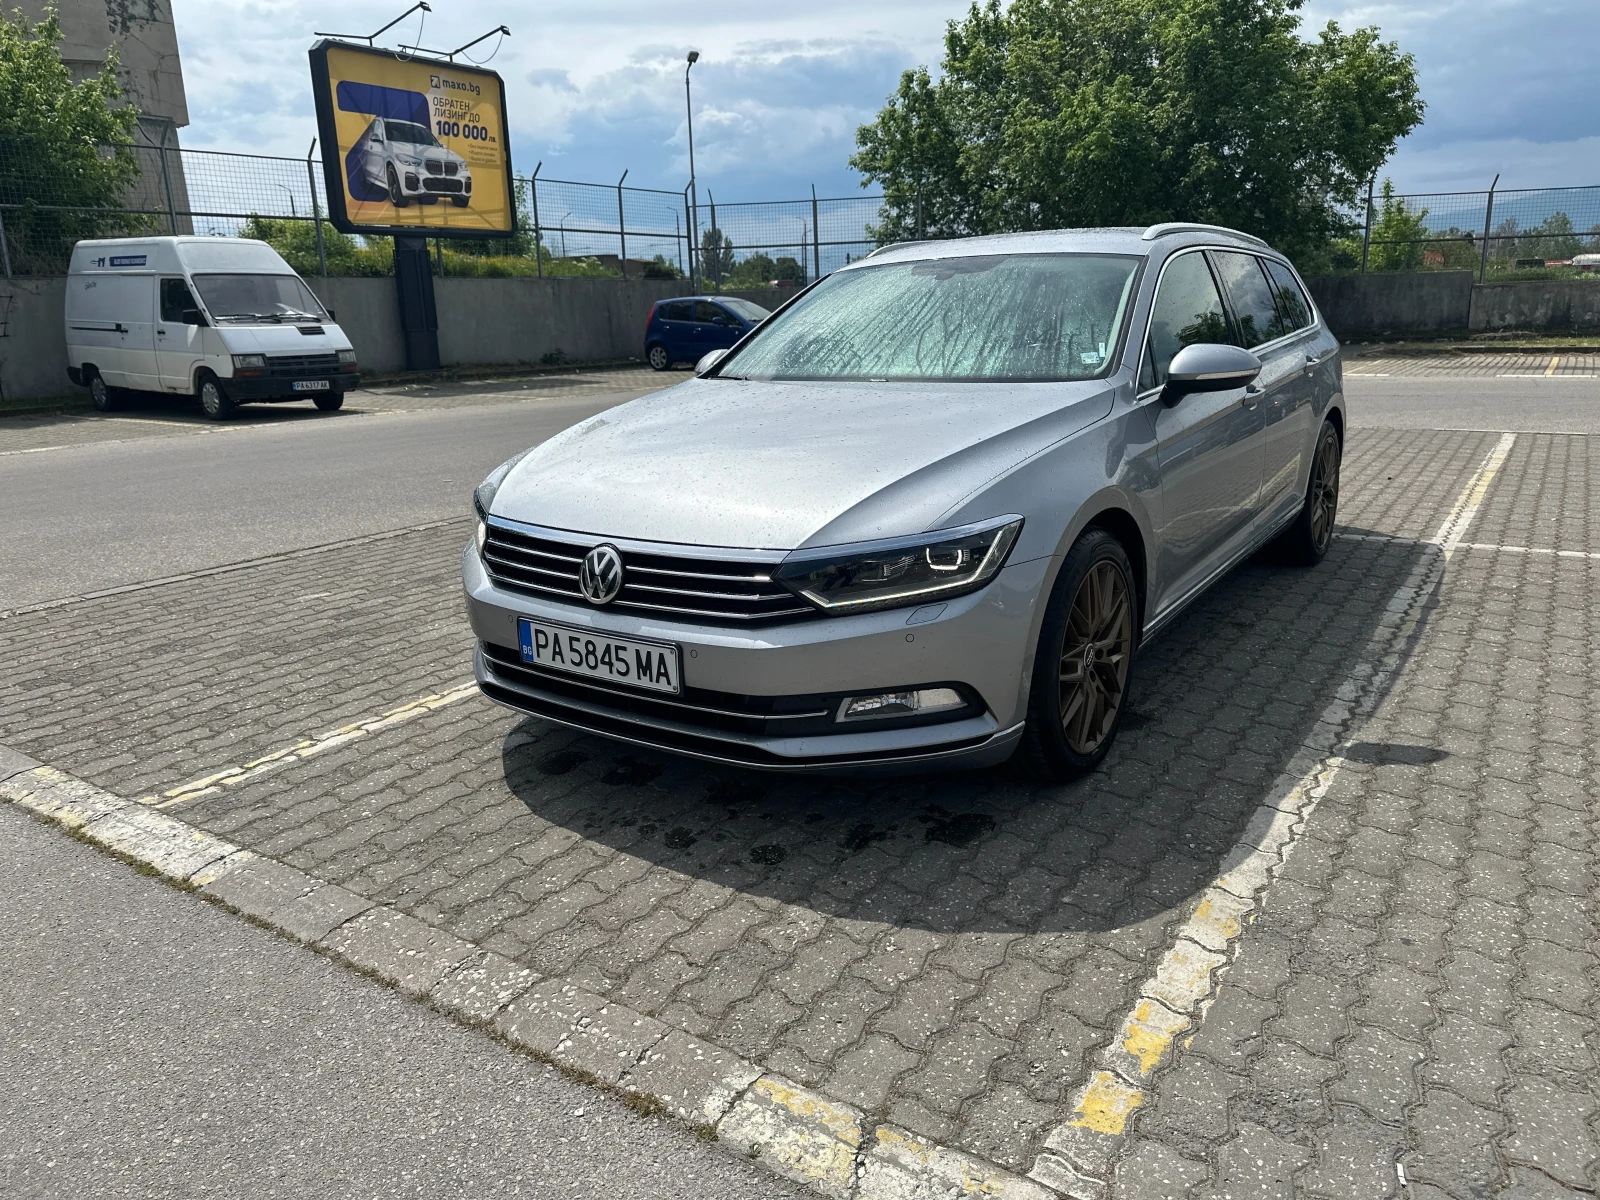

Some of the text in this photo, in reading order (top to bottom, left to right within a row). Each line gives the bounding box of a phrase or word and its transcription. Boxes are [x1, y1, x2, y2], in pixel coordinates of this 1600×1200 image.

[442, 79, 480, 96] maxo.bg
[433, 97, 470, 111] ОБРАТЕН
[434, 108, 480, 123] ЛИЗИНГ ДО
[436, 120, 460, 138] 100
[462, 124, 488, 142] 000
[522, 644, 532, 656] BG
[534, 628, 671, 686] PA 5845 MA
